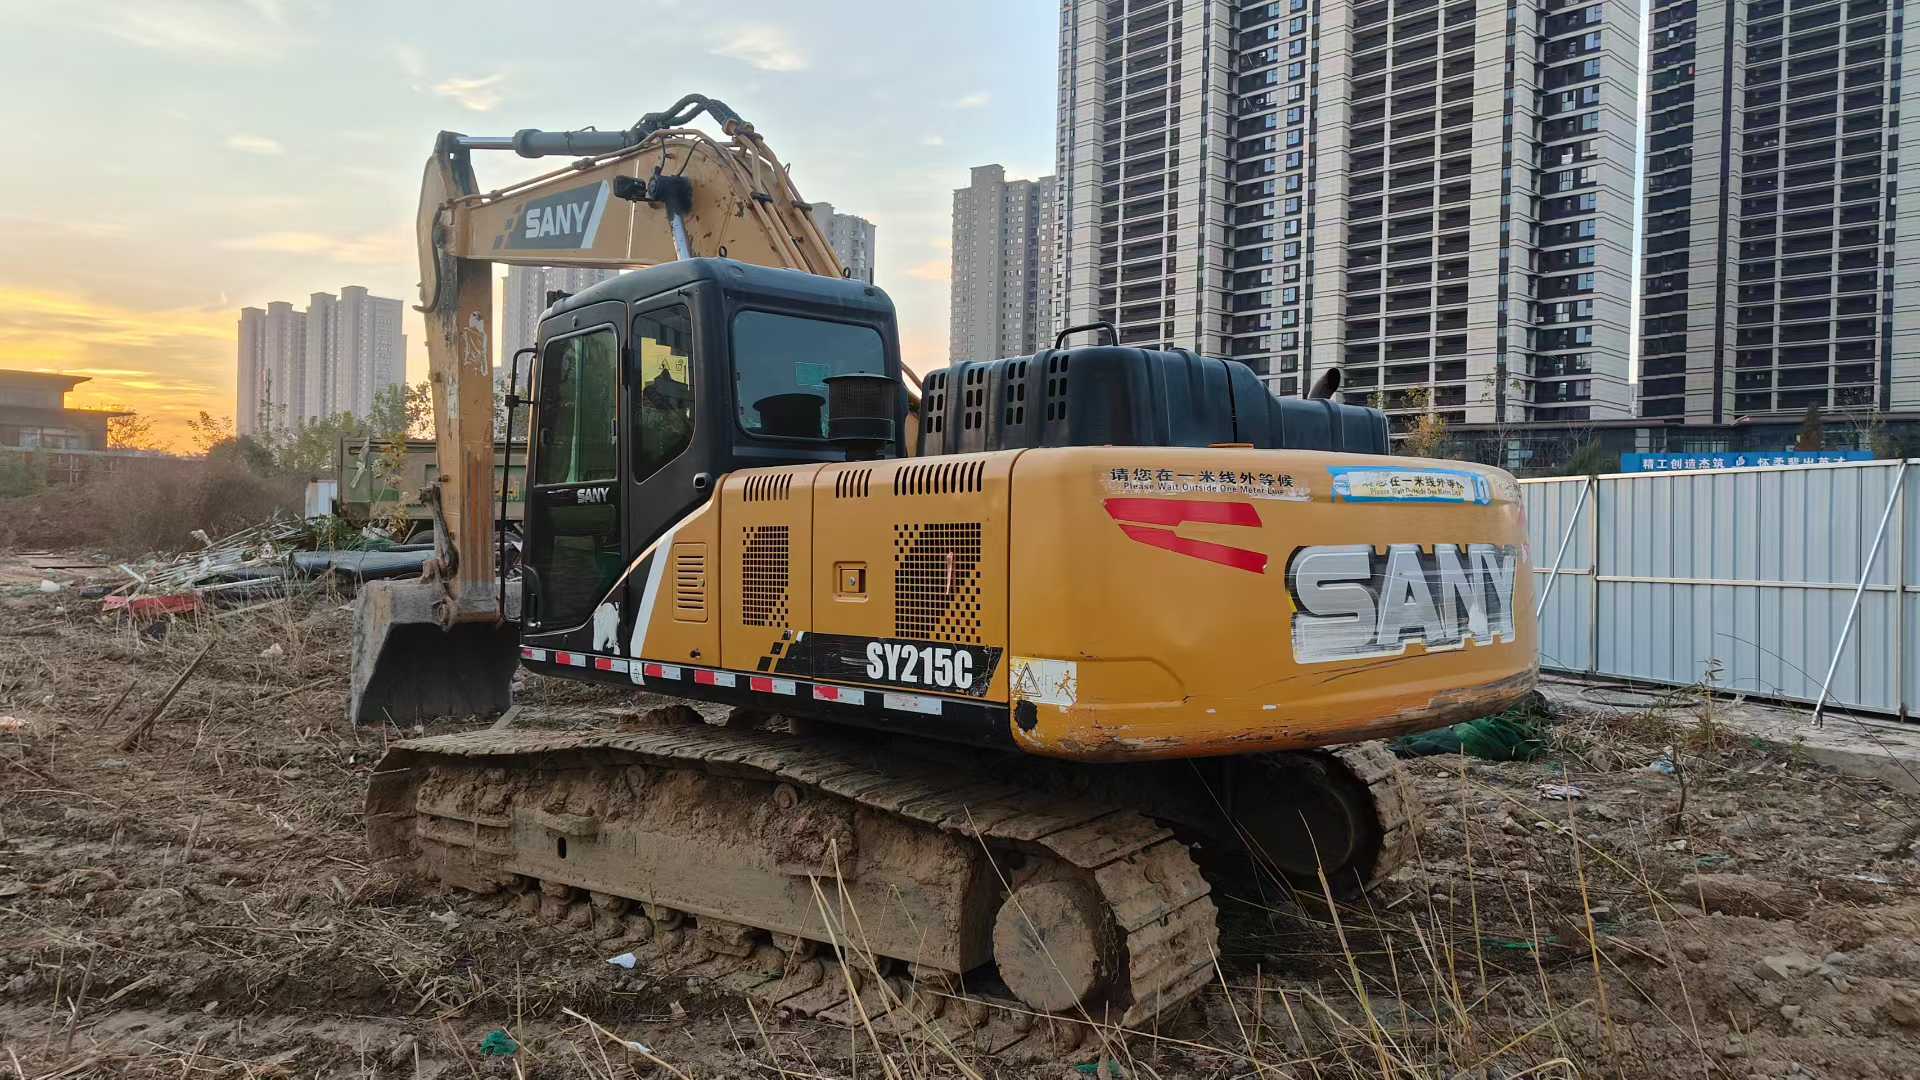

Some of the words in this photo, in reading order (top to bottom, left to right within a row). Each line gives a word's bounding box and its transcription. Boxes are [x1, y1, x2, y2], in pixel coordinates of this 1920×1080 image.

[525, 201, 590, 239] SANY
[1110, 467, 1294, 488] 请您在一米线外等候
[1123, 482, 1154, 491] Please
[1158, 482, 1179, 491] Wait
[1182, 483, 1217, 493] Outside
[1220, 484, 1238, 494] One
[1240, 485, 1264, 495] Meter
[577, 487, 610, 504] SANY
[1288, 544, 1517, 664] SANY
[866, 642, 973, 689] SY215C
